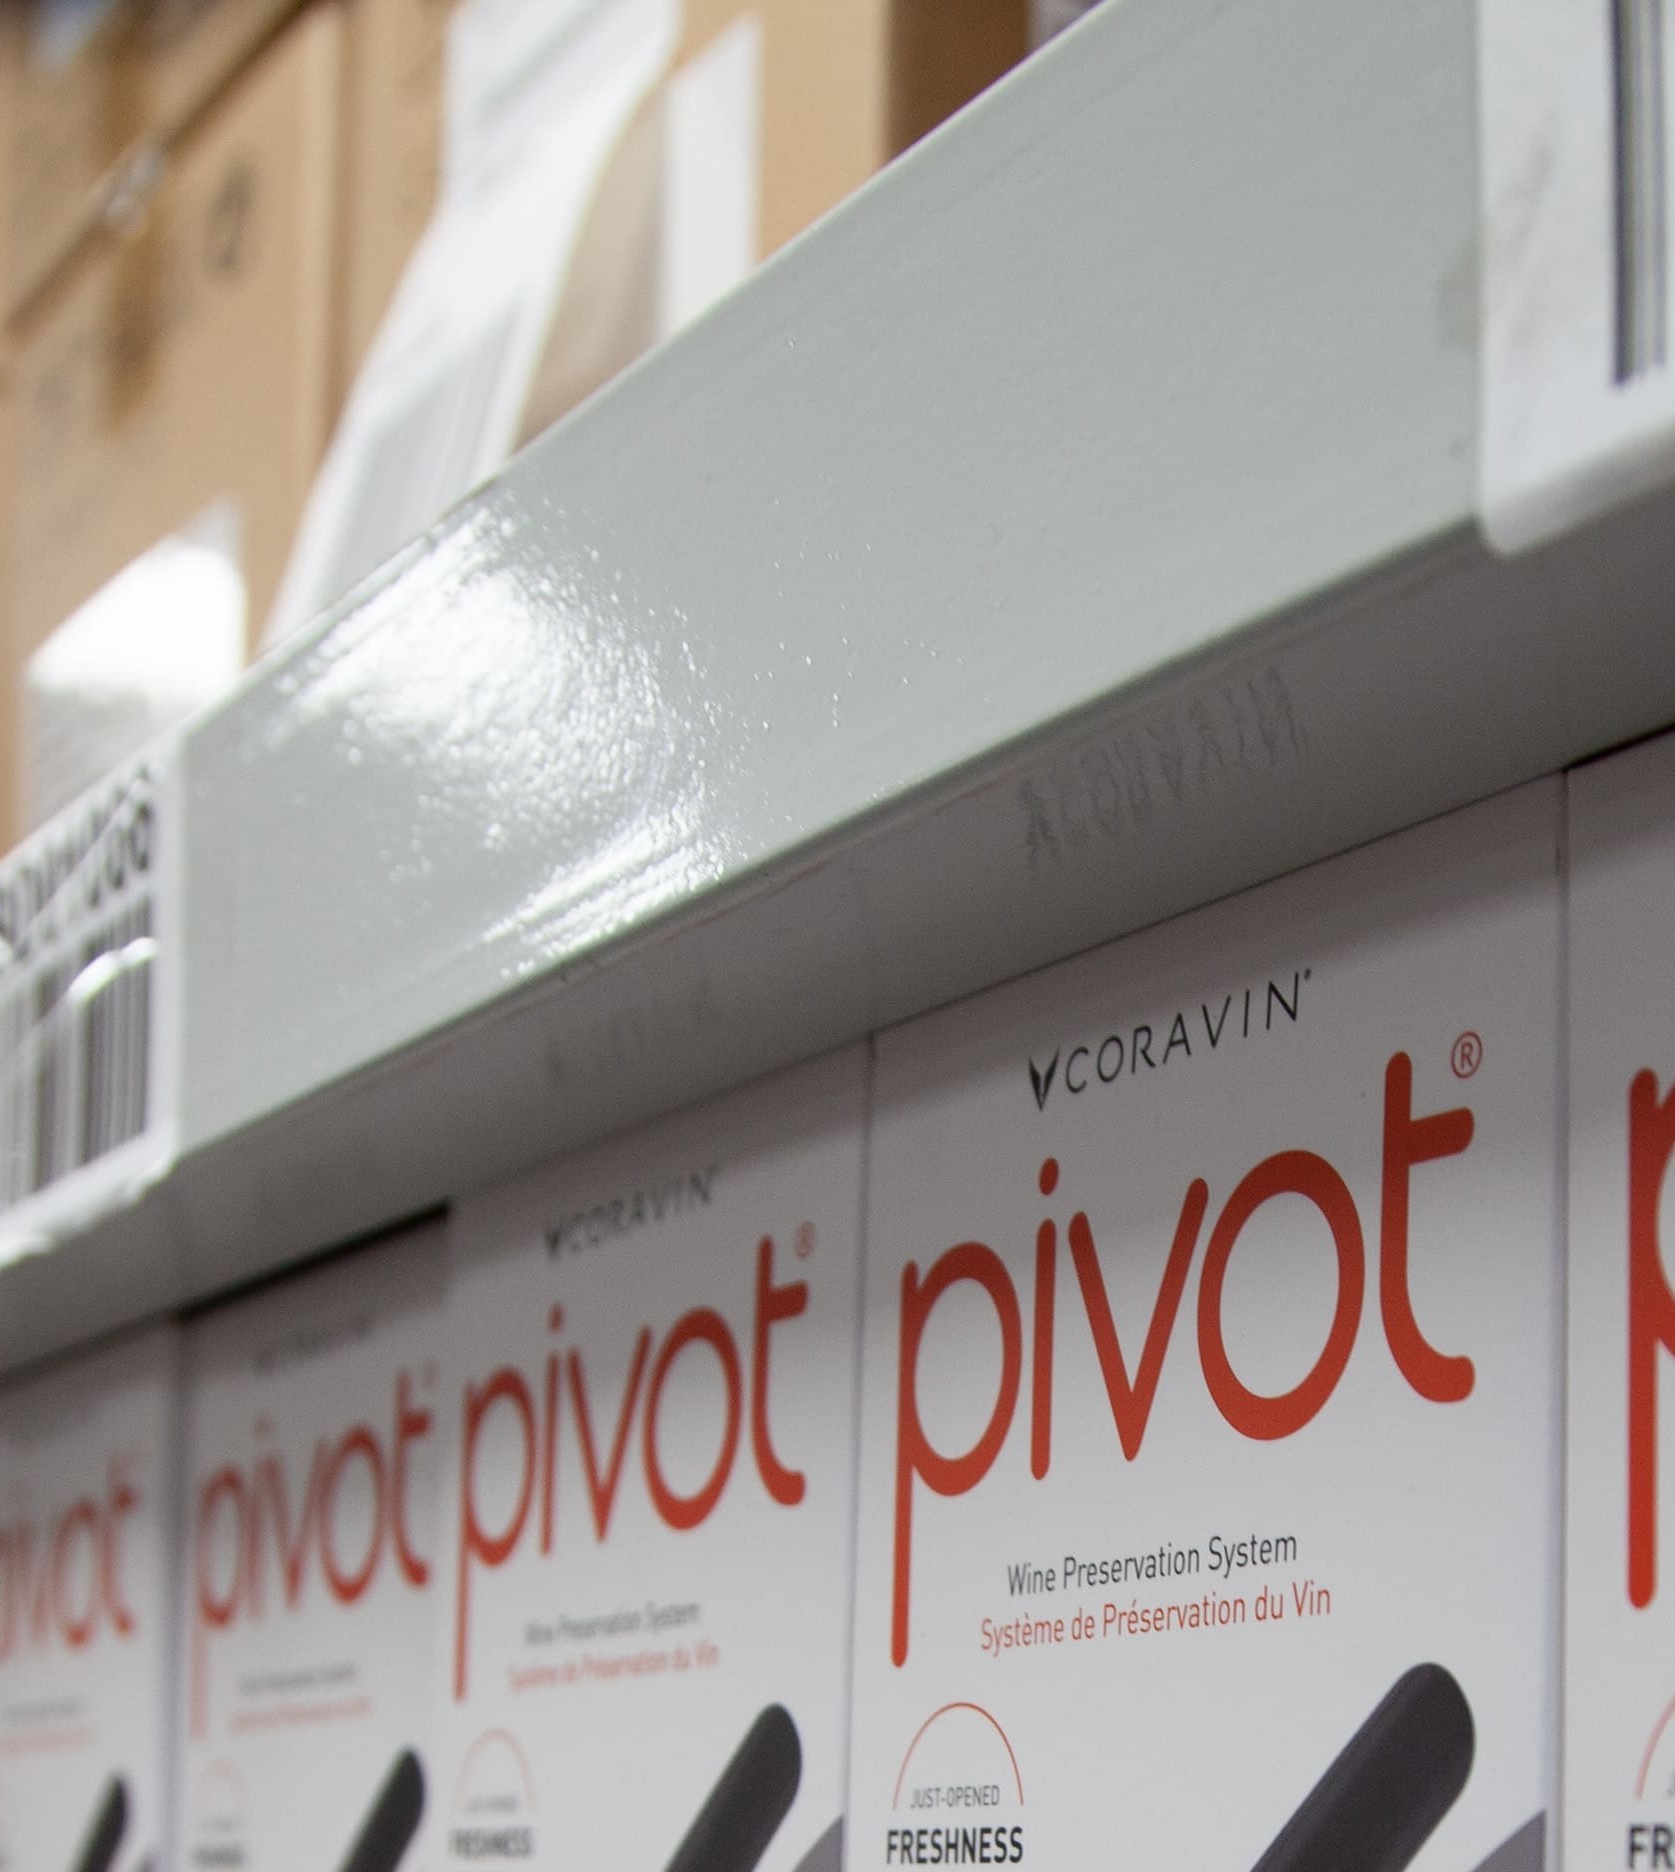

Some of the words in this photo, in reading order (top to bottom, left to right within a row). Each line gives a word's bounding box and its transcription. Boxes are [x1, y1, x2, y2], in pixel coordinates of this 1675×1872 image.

[1065, 970, 1301, 1093] CORAVIN
[1006, 1561, 1056, 1597] Wine
[1062, 1542, 1201, 1590] Preservation
[1208, 1533, 1298, 1579] System
[980, 1612, 1064, 1659] Système
[1071, 1606, 1095, 1641] de
[1102, 1591, 1246, 1638] Préservation
[1254, 1584, 1284, 1621] du
[1292, 1579, 1331, 1617] Vin
[910, 1785, 1000, 1809] JUST-OPENED
[886, 1825, 1023, 1865] FRESHNESS
